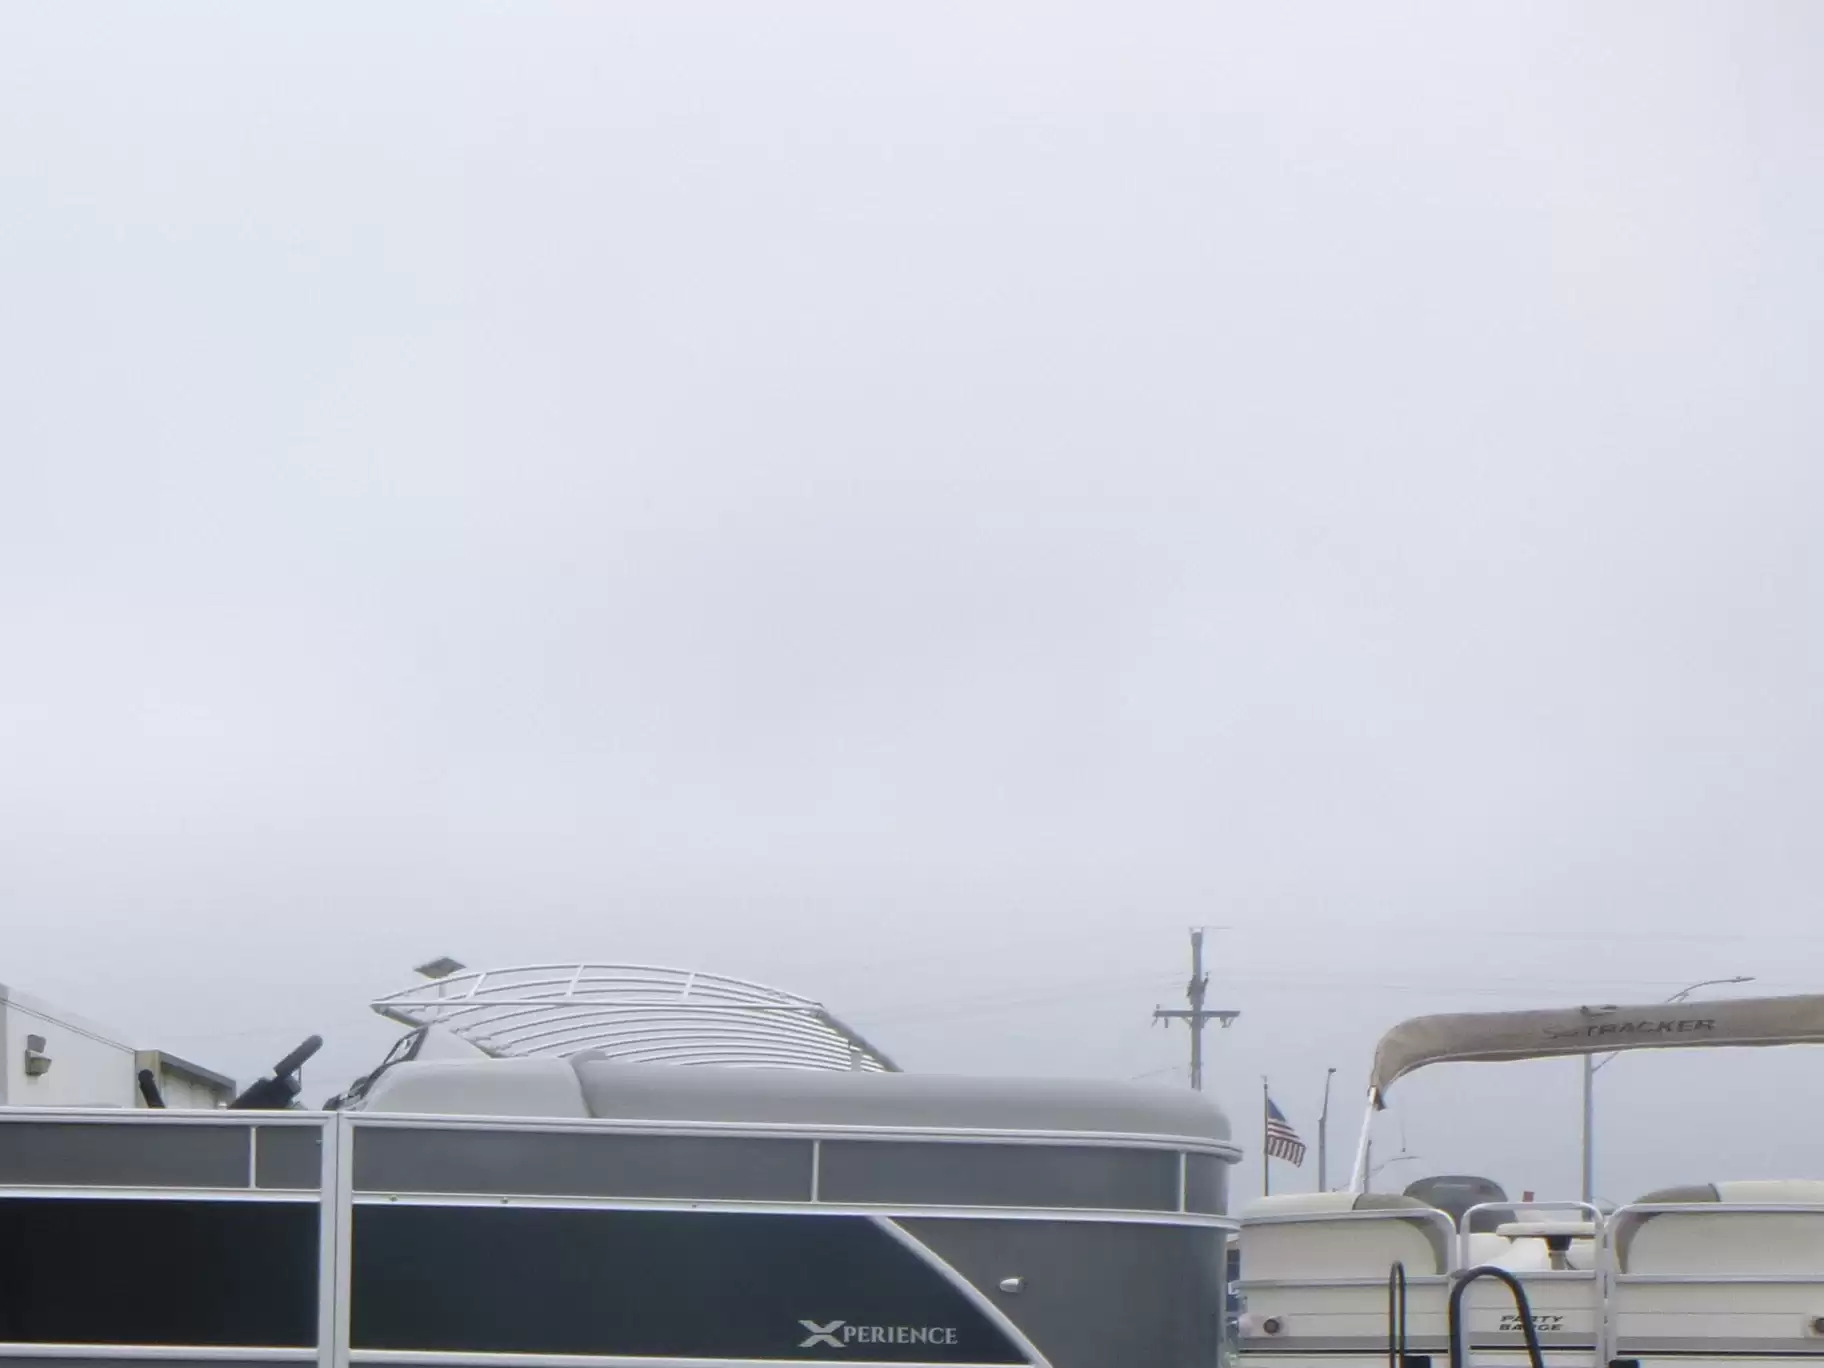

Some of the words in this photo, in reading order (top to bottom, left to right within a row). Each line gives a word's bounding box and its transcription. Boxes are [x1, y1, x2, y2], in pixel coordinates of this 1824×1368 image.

[1587, 1019, 1716, 1037] TRACKER
[797, 1320, 958, 1347] XPERIENCE
[1499, 1323, 1563, 1331] BAGE
